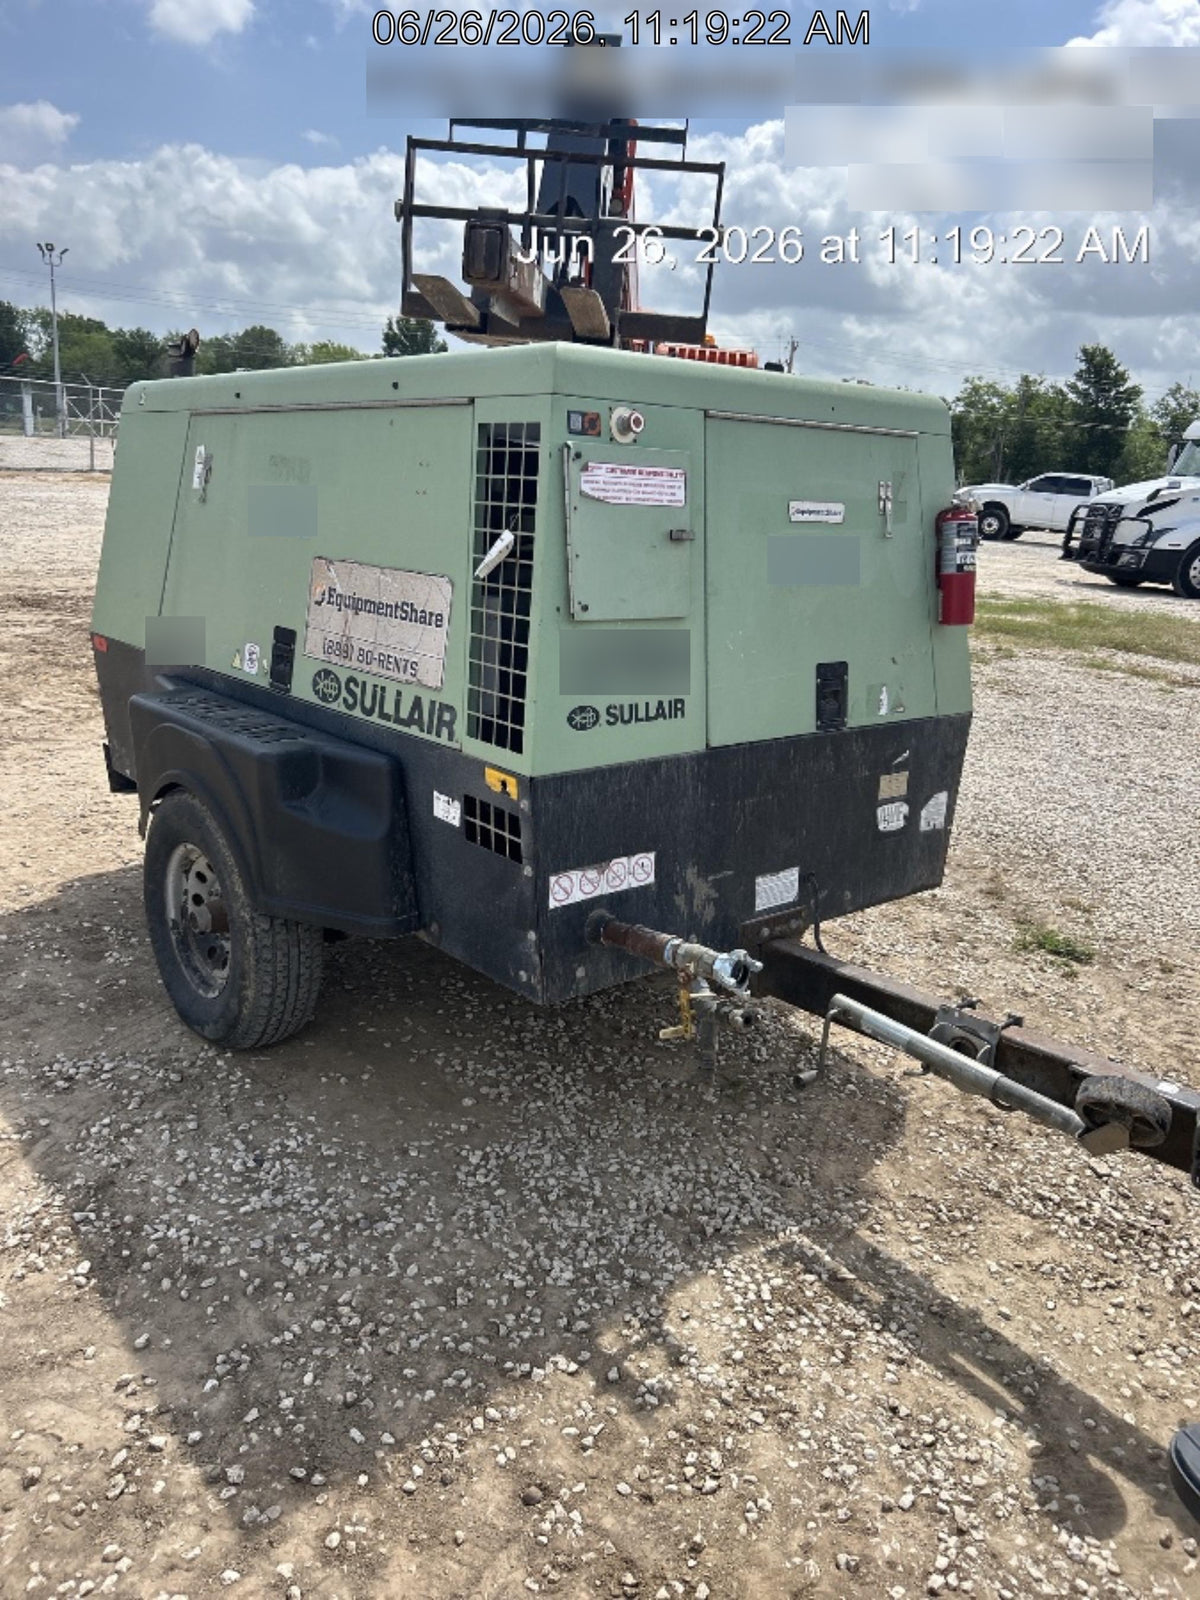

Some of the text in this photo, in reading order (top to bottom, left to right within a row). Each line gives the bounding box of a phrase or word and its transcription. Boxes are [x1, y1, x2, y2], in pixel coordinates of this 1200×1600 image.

[327, 585, 443, 628] EquipmentShare
[357, 649, 419, 678] 80-RENTS
[342, 675, 458, 742] SULLAIR
[605, 698, 685, 726] SULLAIR
